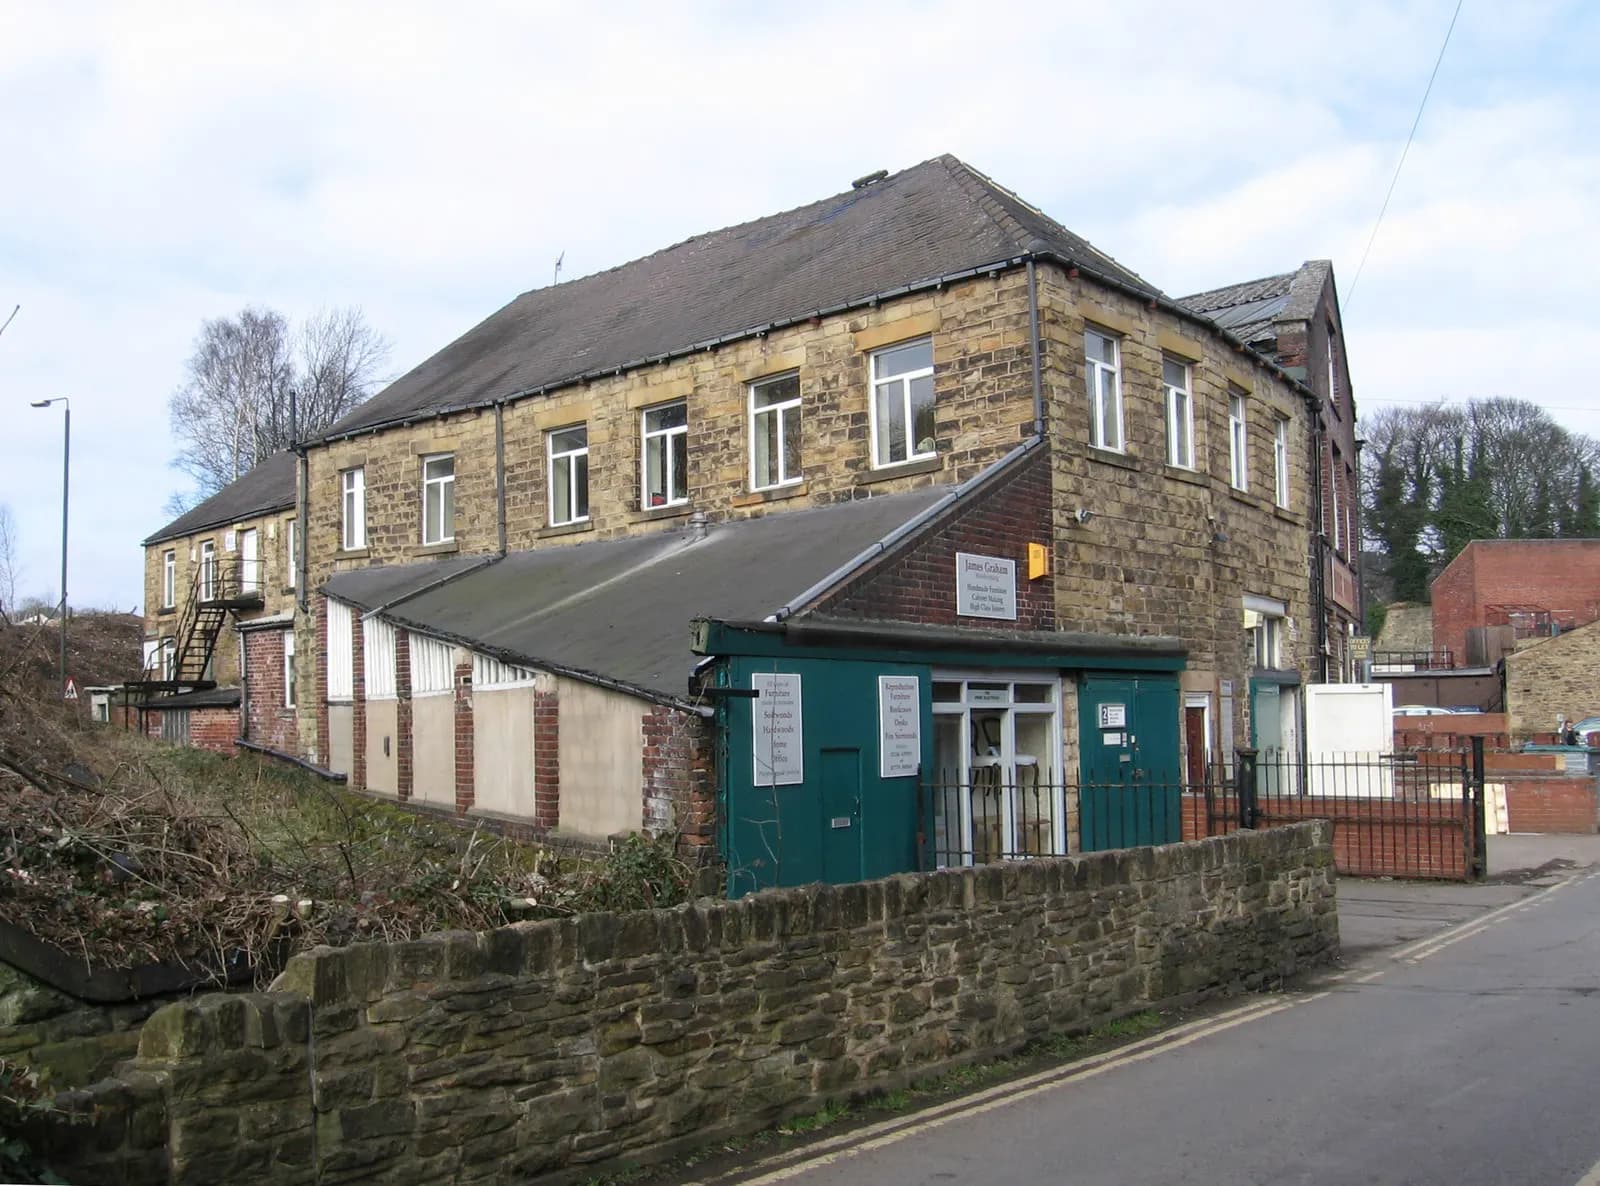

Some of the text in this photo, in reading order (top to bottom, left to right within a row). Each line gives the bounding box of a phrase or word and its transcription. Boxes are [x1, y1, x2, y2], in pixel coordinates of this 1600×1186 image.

[965, 560, 1008, 575] James Graham
[762, 725, 794, 734] Hardwoods
